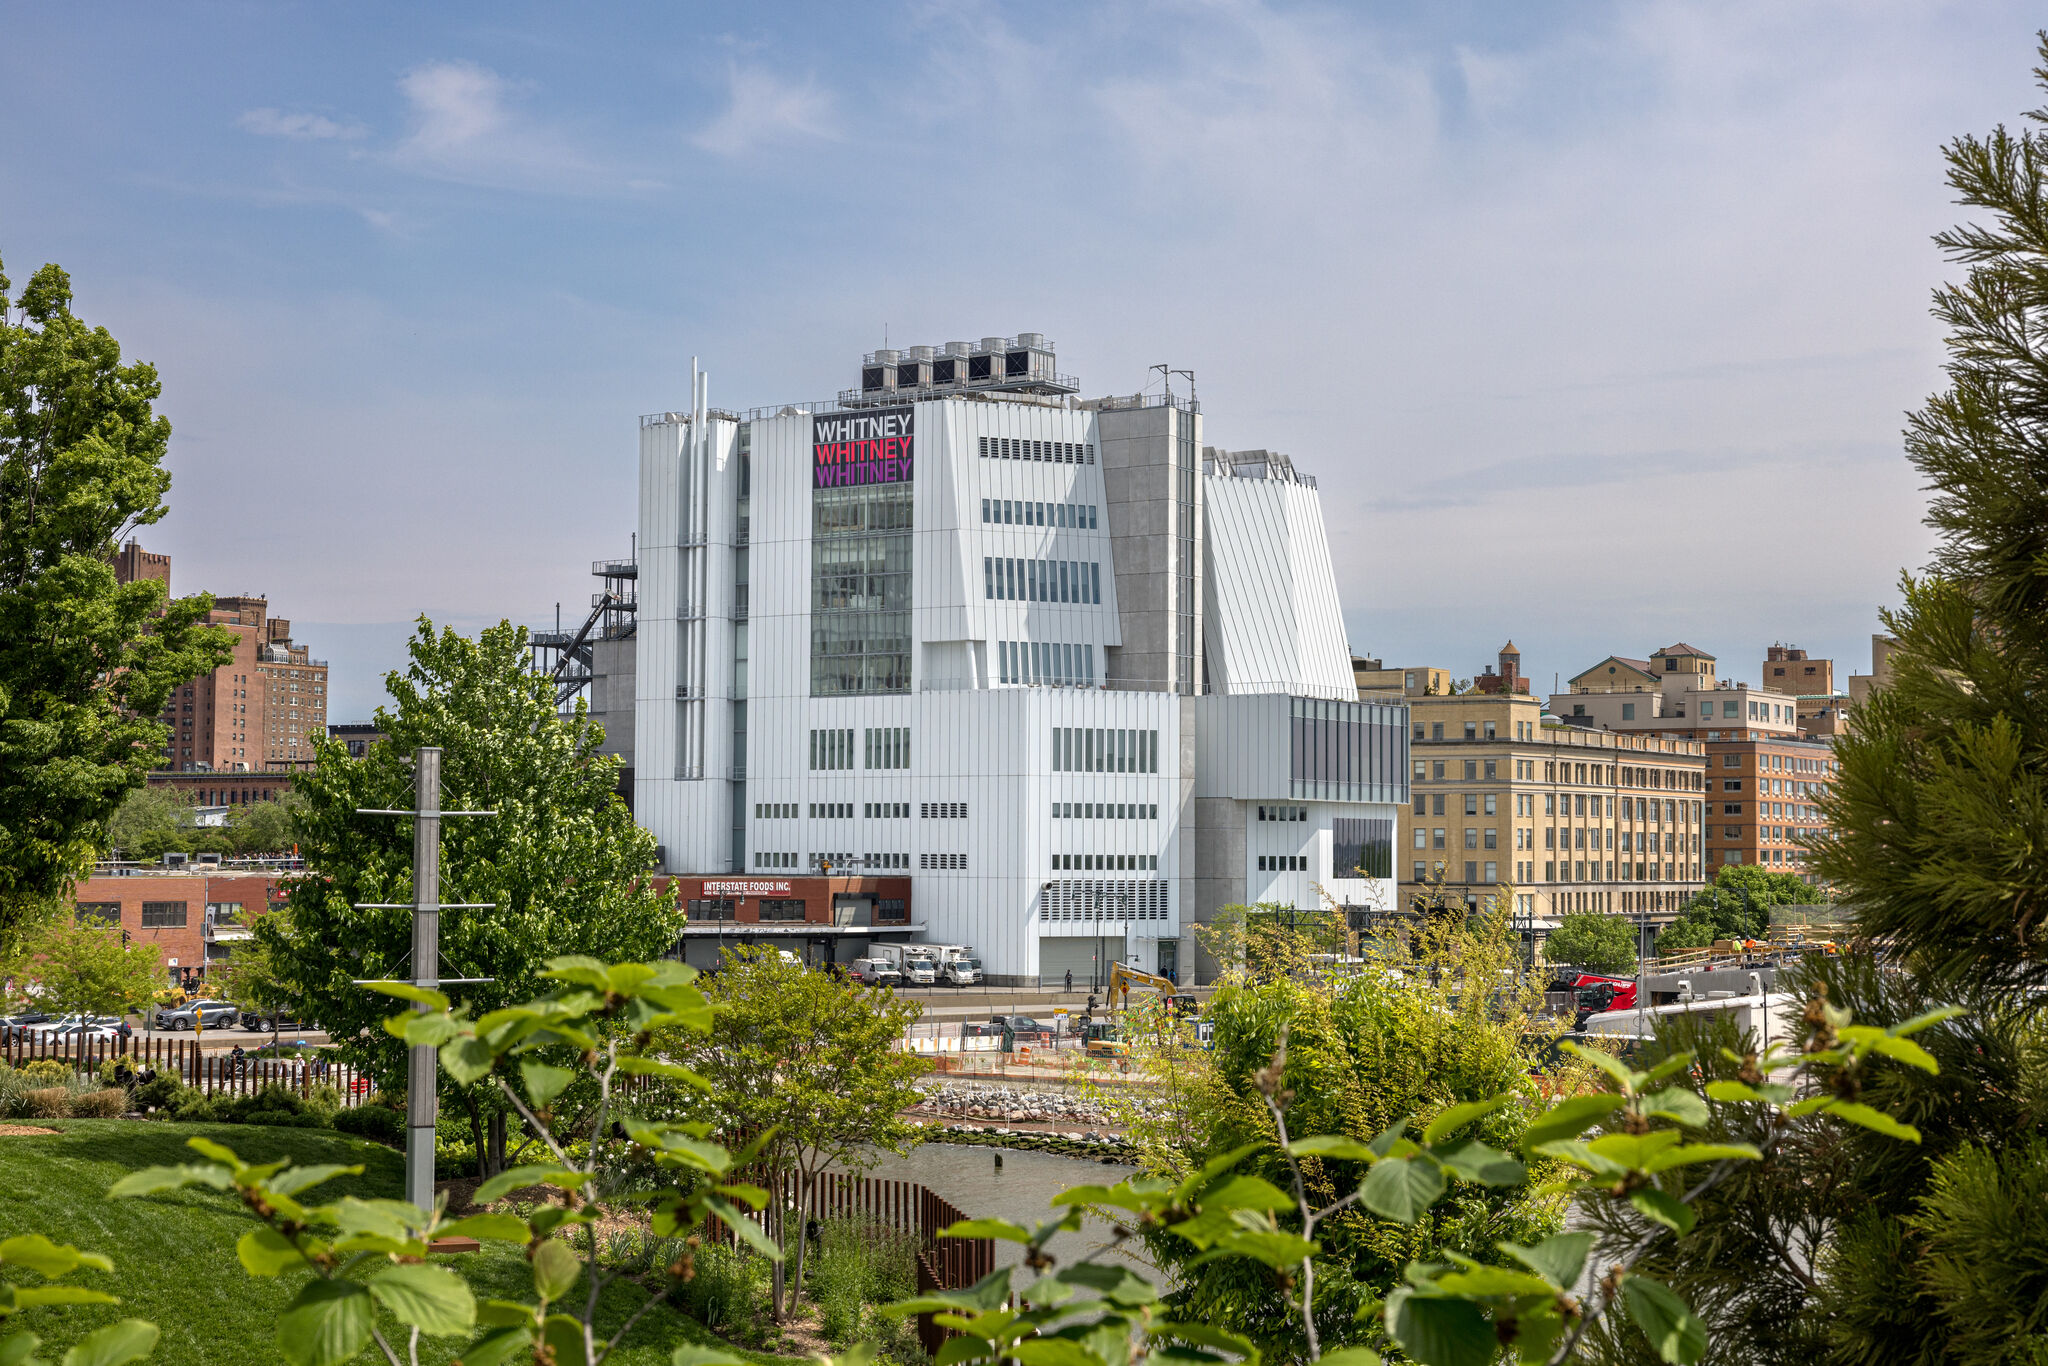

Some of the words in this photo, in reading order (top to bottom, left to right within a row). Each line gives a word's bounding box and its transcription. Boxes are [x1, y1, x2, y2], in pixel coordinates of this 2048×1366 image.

[816, 414, 912, 442] WHITNEY
[816, 436, 912, 465] WHITNEY
[816, 458, 912, 487] WHITNEY
[704, 881, 748, 891] INTERSTATE
[749, 881, 774, 891] FOODS
[775, 881, 791, 891] INC.
